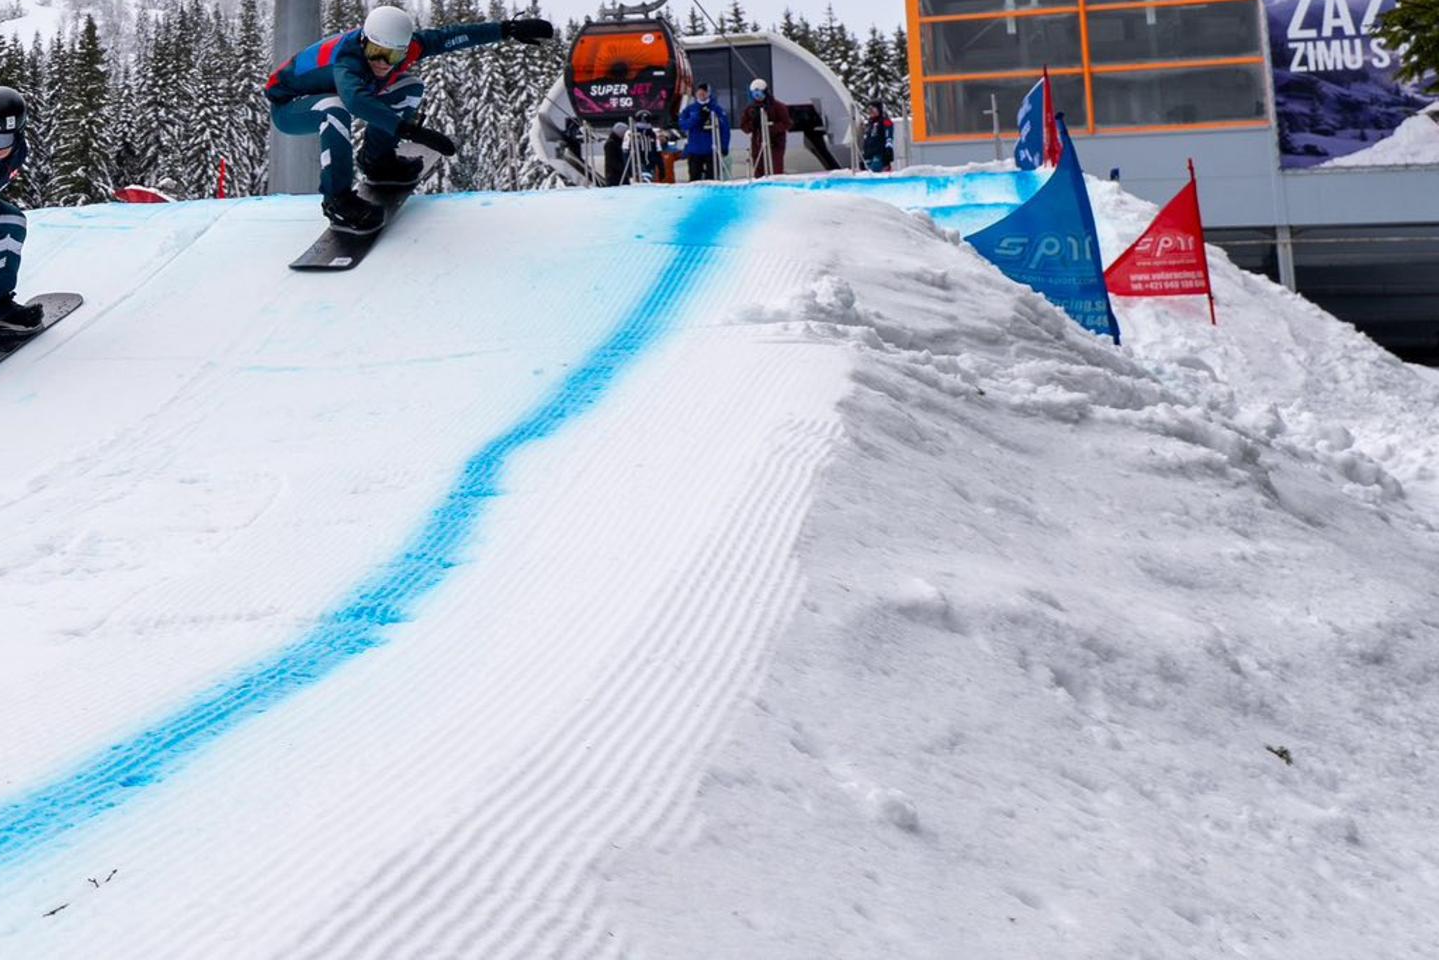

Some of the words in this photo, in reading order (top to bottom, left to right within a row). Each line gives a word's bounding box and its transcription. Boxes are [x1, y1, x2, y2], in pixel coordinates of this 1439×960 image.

[1288, 38, 1364, 73] ZIMU
[1370, 36, 1392, 70] S
[590, 83, 628, 96] SUPER
[631, 82, 652, 95] JET
